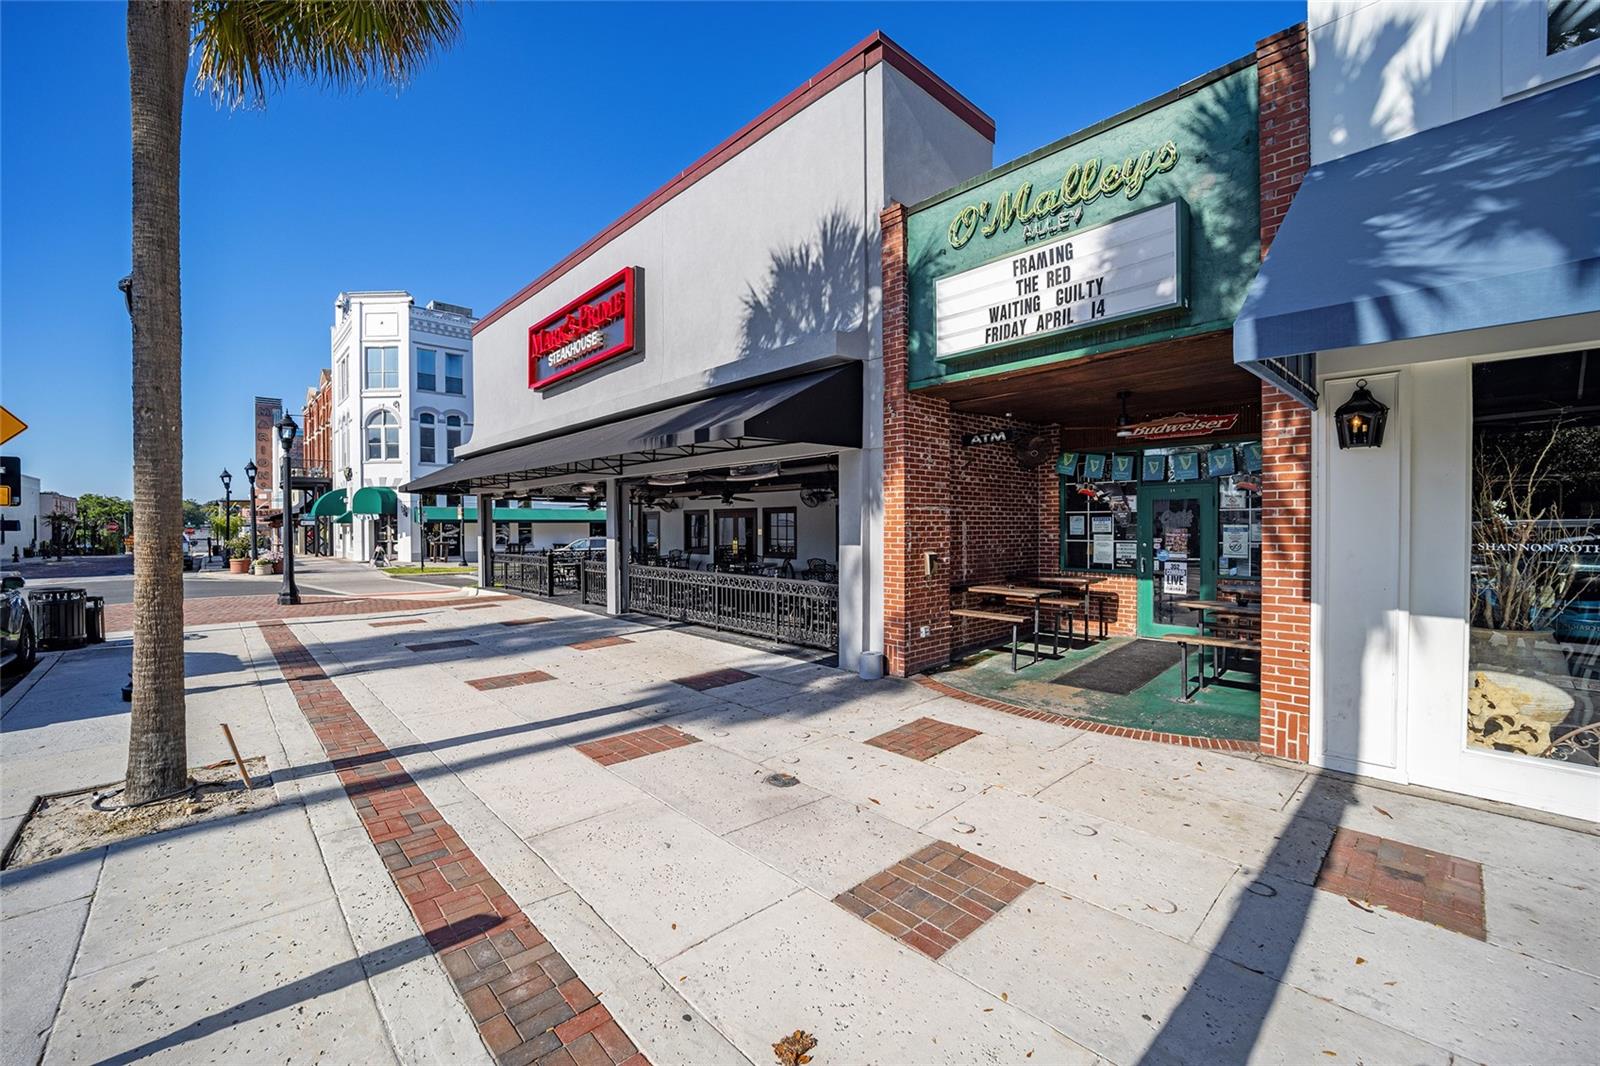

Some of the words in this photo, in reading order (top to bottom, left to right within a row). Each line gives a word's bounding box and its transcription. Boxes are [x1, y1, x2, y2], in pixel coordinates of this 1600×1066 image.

[1023, 206, 1084, 242] ALLEY
[1012, 242, 1074, 278] FRAMING
[1015, 277, 1039, 296] THE
[1046, 265, 1072, 289] RED
[989, 294, 1041, 324] WAITING
[1057, 278, 1104, 304] GUILTY
[985, 319, 1026, 344] FRIDAY
[1036, 307, 1074, 331] APRIL
[1091, 298, 1106, 319] 14
[548, 331, 604, 367] STEAKHOUSE
[970, 431, 1007, 445] ATM
[1133, 418, 1229, 436] Budweiser
[1477, 543, 1553, 552] SHANNON
[1167, 576, 1183, 585] LIVE
